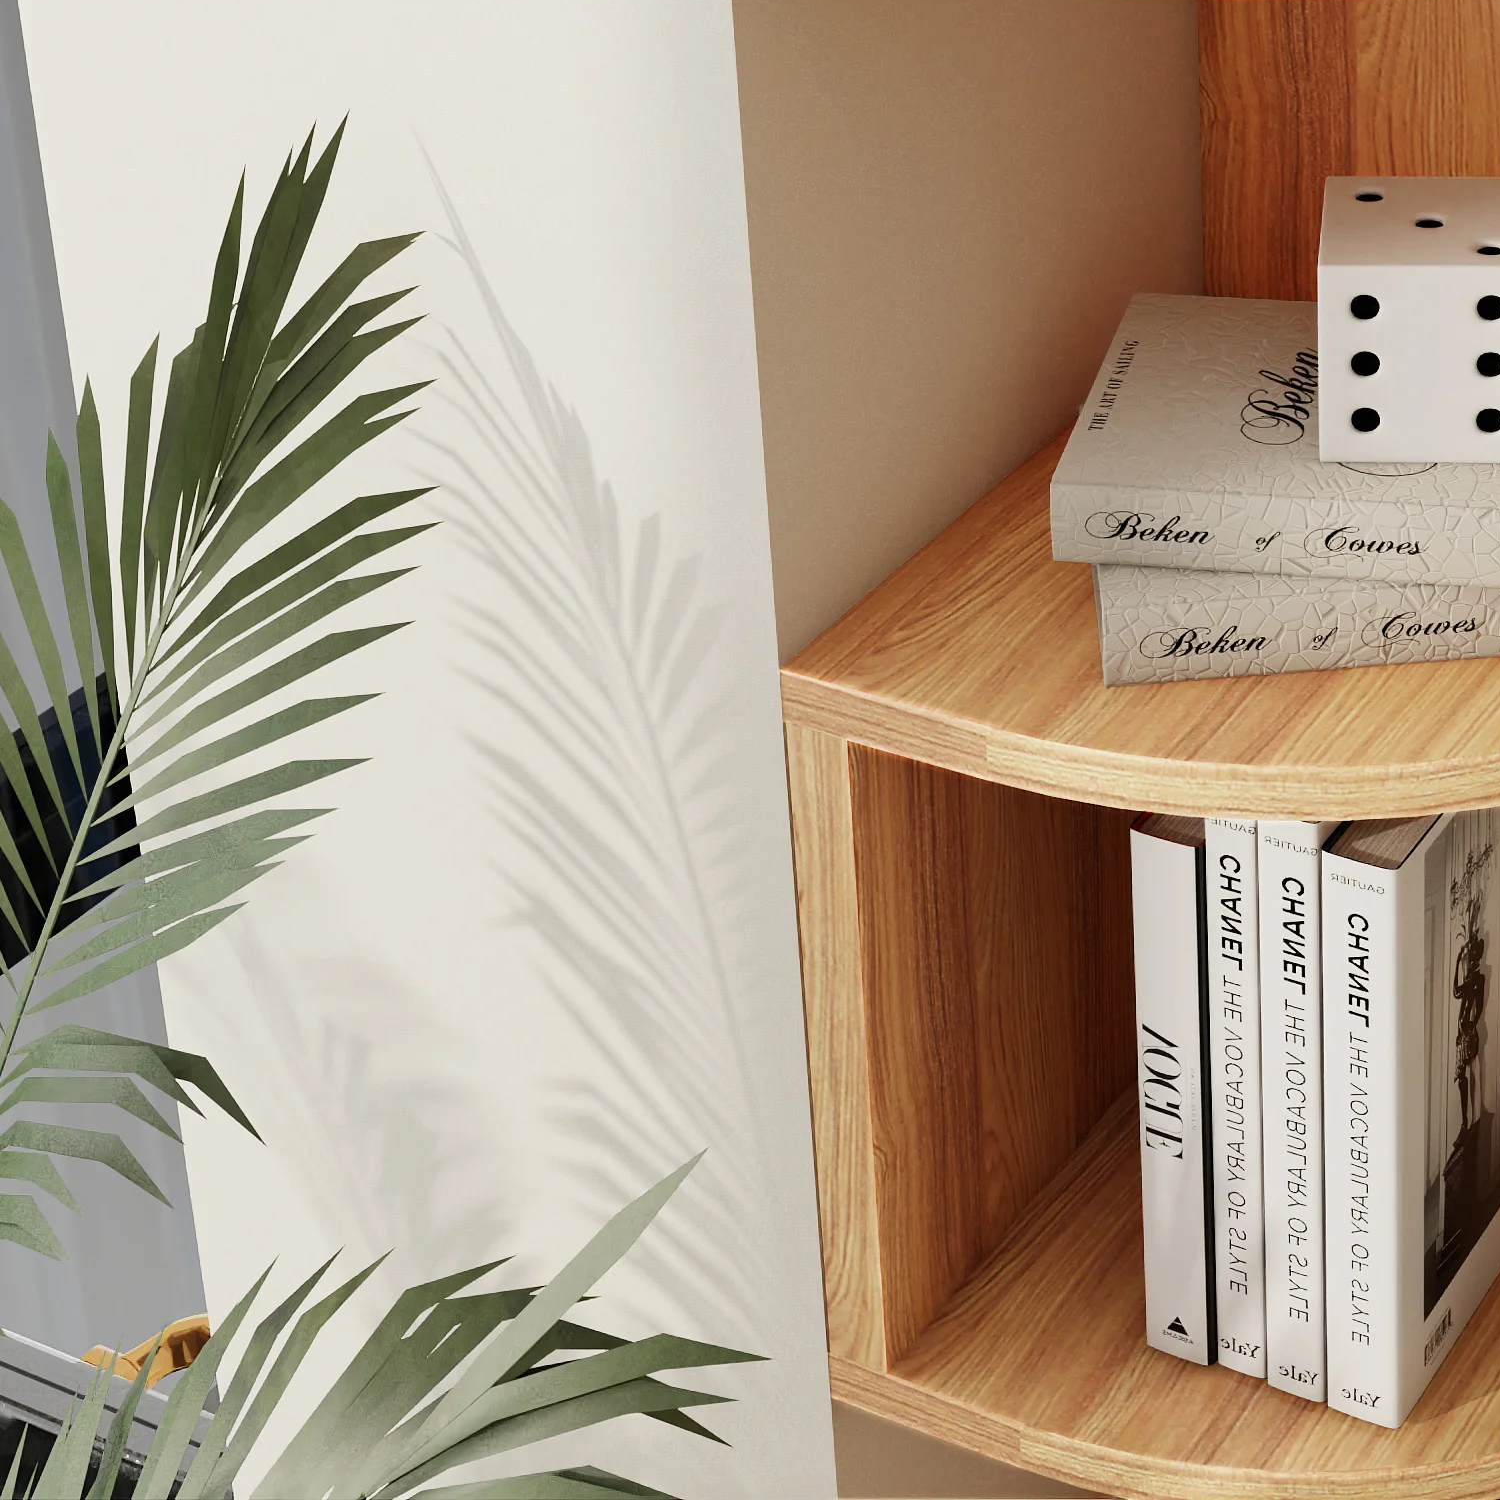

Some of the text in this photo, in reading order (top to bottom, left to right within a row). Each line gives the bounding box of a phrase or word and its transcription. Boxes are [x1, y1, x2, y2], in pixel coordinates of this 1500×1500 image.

[1088, 340, 1139, 431] THE ART OF SAILING
[1240, 347, 1319, 445] Beken
[1084, 510, 1429, 563] Beken of Cowes
[1139, 611, 1485, 659] Beken of Cowes
